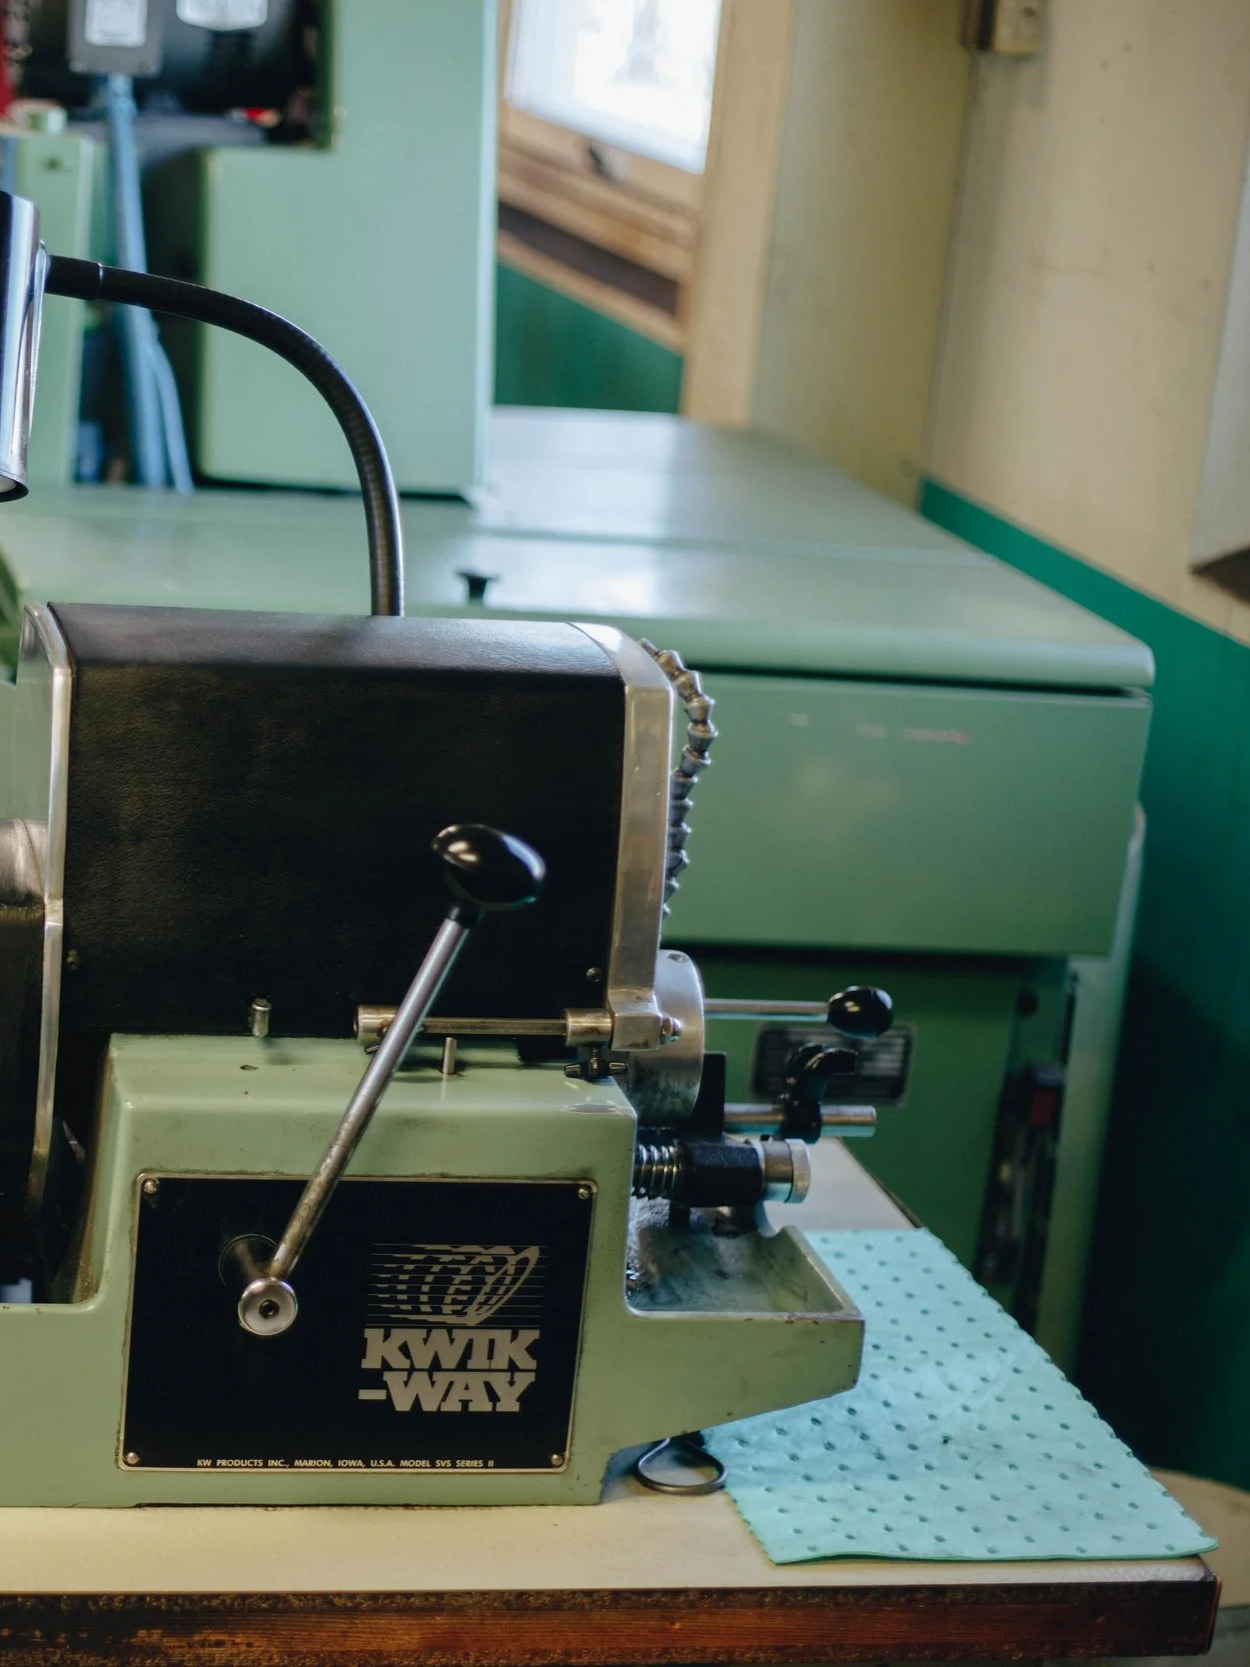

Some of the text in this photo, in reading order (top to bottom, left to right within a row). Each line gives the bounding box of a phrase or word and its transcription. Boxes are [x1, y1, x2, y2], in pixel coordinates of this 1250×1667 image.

[361, 1328, 540, 1370] KWIK
[197, 1459, 212, 1467] KW
[216, 1459, 263, 1467] PRODUCTS
[294, 1459, 333, 1468] MARION,
[338, 1459, 365, 1468] IOWA,
[370, 1459, 395, 1467] U.S.A.
[399, 1459, 430, 1467] MODEL
[456, 1459, 483, 1467] SERIES
[488, 1459, 494, 1467] II
